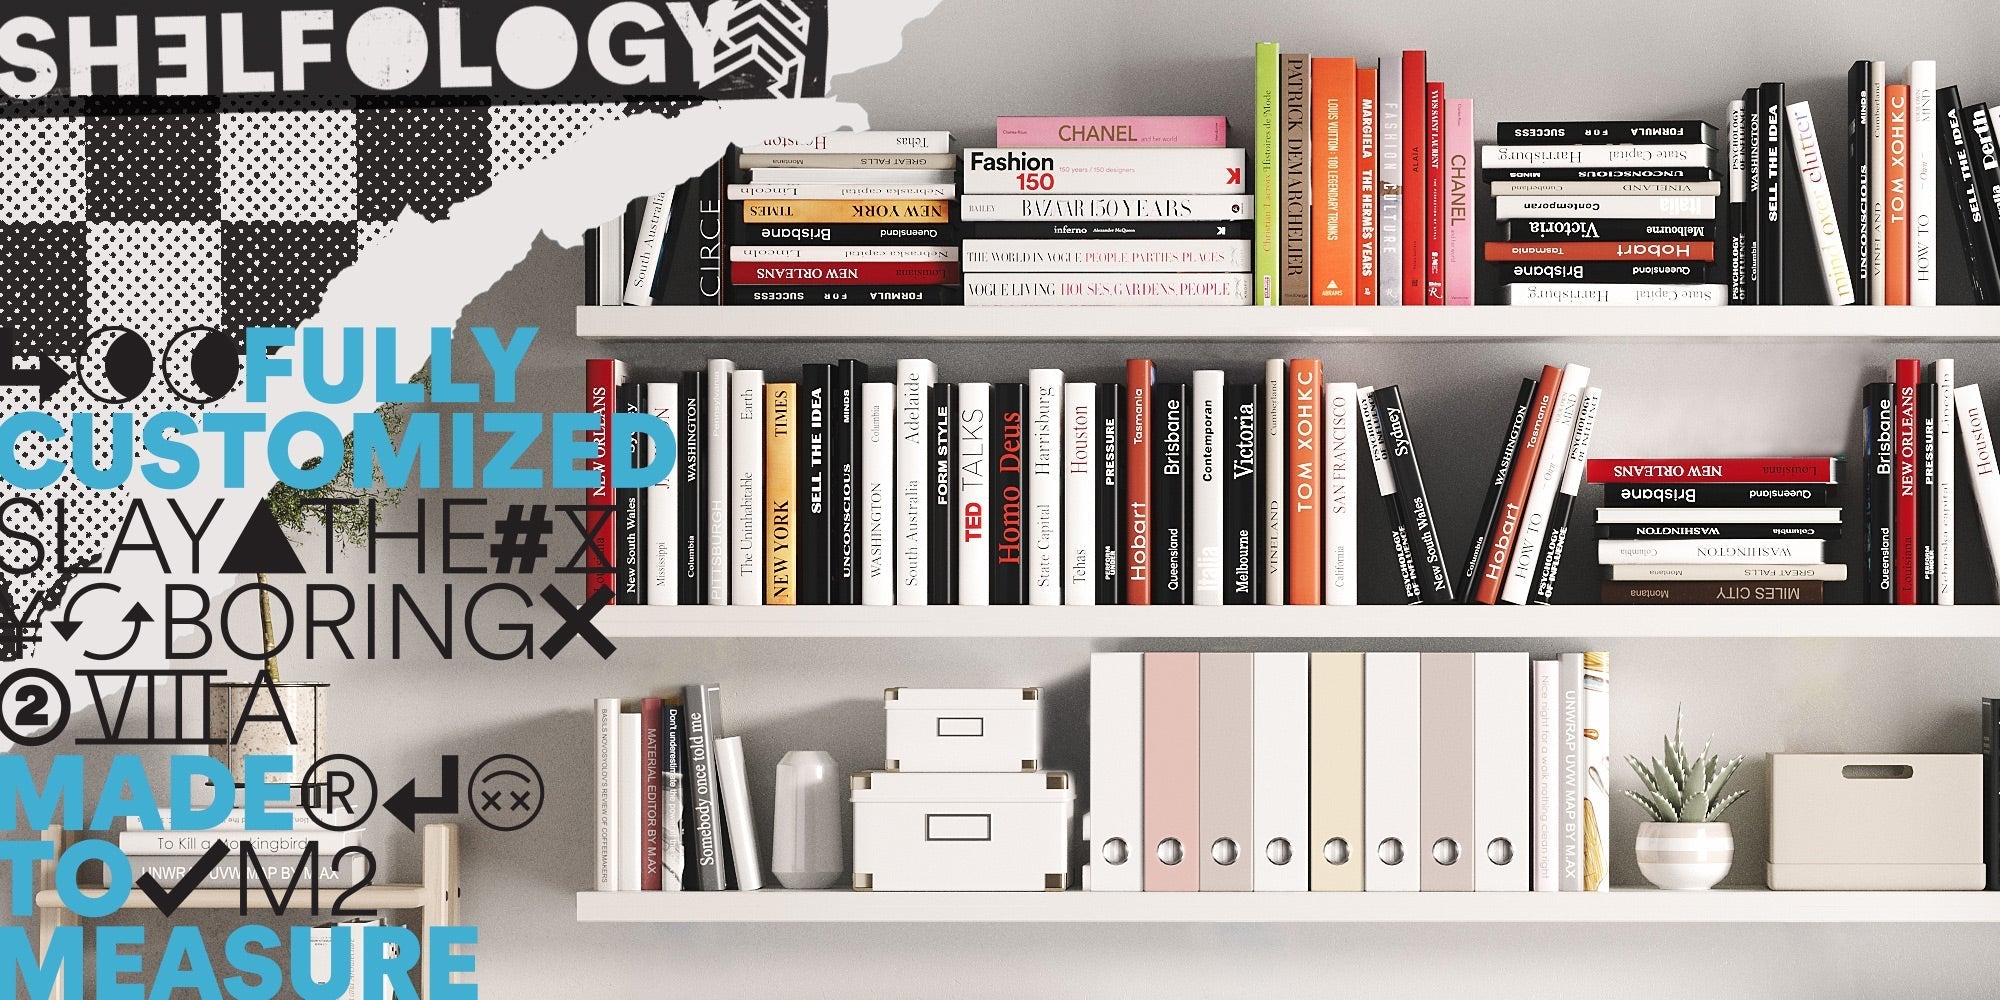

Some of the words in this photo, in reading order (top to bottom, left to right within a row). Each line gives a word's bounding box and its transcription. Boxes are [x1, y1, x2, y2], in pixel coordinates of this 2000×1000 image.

[1287, 58, 1303, 131] PATRICK
[1328, 99, 1338, 119] LOUIS
[1058, 125, 1137, 142] CHANEL
[1363, 99, 1372, 159] MARGIELA
[1384, 103, 1398, 170] FASHION
[1514, 128, 1565, 137] SUCCESS
[1630, 128, 1684, 136] FORMULA
[1769, 104, 1778, 140] IDEA
[1892, 96, 1904, 166] XOHKC
[1794, 112, 1821, 183] clutter
[1972, 109, 1999, 171] Perth
[971, 152, 1054, 171] Fashion
[1328, 156, 1338, 168] 100
[1769, 145, 1778, 178] THE
[1016, 173, 1054, 191] 150
[1328, 170, 1338, 202] LEGENDARY
[1363, 170, 1372, 192] THE
[1451, 154, 1466, 226] CHANEL
[750, 206, 793, 216] TIMES
[852, 205, 900, 216] YORK
[904, 205, 942, 216] NEW
[1022, 200, 1085, 216] BAZAAR
[1122, 200, 1192, 216] YEARS
[1287, 139, 1303, 276] DEMARCHELIER
[1363, 195, 1373, 240] HERMÈS
[1769, 182, 1778, 221] SELL
[1892, 178, 1904, 223] TOM
[762, 228, 830, 240] Brisbane
[881, 229, 937, 238] Queensland
[1054, 226, 1087, 234] inferno
[1328, 204, 1338, 241] TRUNKS
[1383, 183, 1397, 254] CULTURE
[1529, 221, 1600, 238] Victoria
[1646, 226, 1704, 236] Melbourne
[700, 199, 720, 297] CIRCE
[1363, 242, 1372, 277] YEARS
[1617, 244, 1689, 257] Hobart
[634, 254, 651, 288] South
[756, 268, 823, 279] ORLEANS
[825, 268, 858, 279] NEW
[1514, 265, 1583, 278] Brisbane
[1633, 267, 1690, 275] Queensland
[753, 292, 804, 300] SUCCESS
[824, 292, 848, 300] FOR
[869, 292, 923, 300] FORMULA
[775, 390, 787, 437] TIMES
[812, 388, 822, 427] IDEA
[904, 373, 919, 444] Adelaide
[1134, 388, 1143, 444] Tasmania
[1298, 372, 1313, 450] XOHKC
[1902, 387, 1914, 458] ORLEANS
[688, 398, 696, 482] WASHINGTON
[938, 407, 948, 456] STYLE
[1001, 413, 1020, 473] Deus
[1071, 406, 1088, 473] Houston
[1164, 400, 1179, 475] Brisbane
[1234, 403, 1254, 479] Victoria
[1333, 397, 1346, 480] FRANCISCO
[1387, 407, 1408, 457] Sydney
[1969, 407, 1993, 476] Houston
[812, 434, 822, 467] THE
[962, 409, 983, 491] TALKS
[1106, 419, 1115, 485] PRESSURE
[938, 461, 948, 505] FORM
[1298, 462, 1313, 512] TOM
[1486, 503, 1519, 579] Hobart
[1527, 395, 1549, 449] Tasmania
[1613, 465, 1684, 477] ORLEANS
[1687, 465, 1722, 477] NEW
[1902, 464, 1913, 496] NEW
[812, 473, 822, 514] SELL
[1333, 484, 1346, 514] SAN
[1621, 488, 1696, 502] Brisbane
[1749, 490, 1812, 500] Queensland
[627, 497, 635, 532] Wales
[773, 500, 789, 550] YORK
[906, 480, 918, 544] Australia
[965, 503, 982, 542] TED
[999, 486, 1020, 564] Homo
[1414, 497, 1428, 528] Wales
[871, 483, 882, 578] WASHINGTON
[1131, 501, 1146, 580] Hobart
[1425, 530, 1438, 563] South
[627, 534, 635, 566] South
[906, 547, 918, 586] South
[1073, 550, 1086, 584] Tehas
[1168, 528, 1178, 590] Queensland
[1236, 529, 1248, 593] Melbourne
[1335, 546, 1345, 588] California
[627, 569, 635, 593] New
[774, 557, 788, 597] NEW
[1433, 566, 1445, 591] New
[1631, 589, 1669, 598] Montana
[1716, 587, 1751, 600] CITY
[1755, 587, 1800, 600] MILES
[691, 712, 702, 735] me
[1566, 690, 1575, 751] UNWRAP
[648, 728, 656, 783] MATERIAL
[690, 736, 705, 762] told
[694, 763, 708, 795] once
[1566, 755, 1575, 786] UVW
[648, 785, 656, 826] EDITOR
[1566, 789, 1575, 819] MAP
[158, 838, 174, 849] To
[179, 837, 195, 849] Kill
[648, 829, 656, 845] BY
[695, 799, 714, 865] Somebody
[1566, 824, 1575, 843] BY
[648, 849, 656, 874] M.AX
[1566, 846, 1575, 878] M.AX
